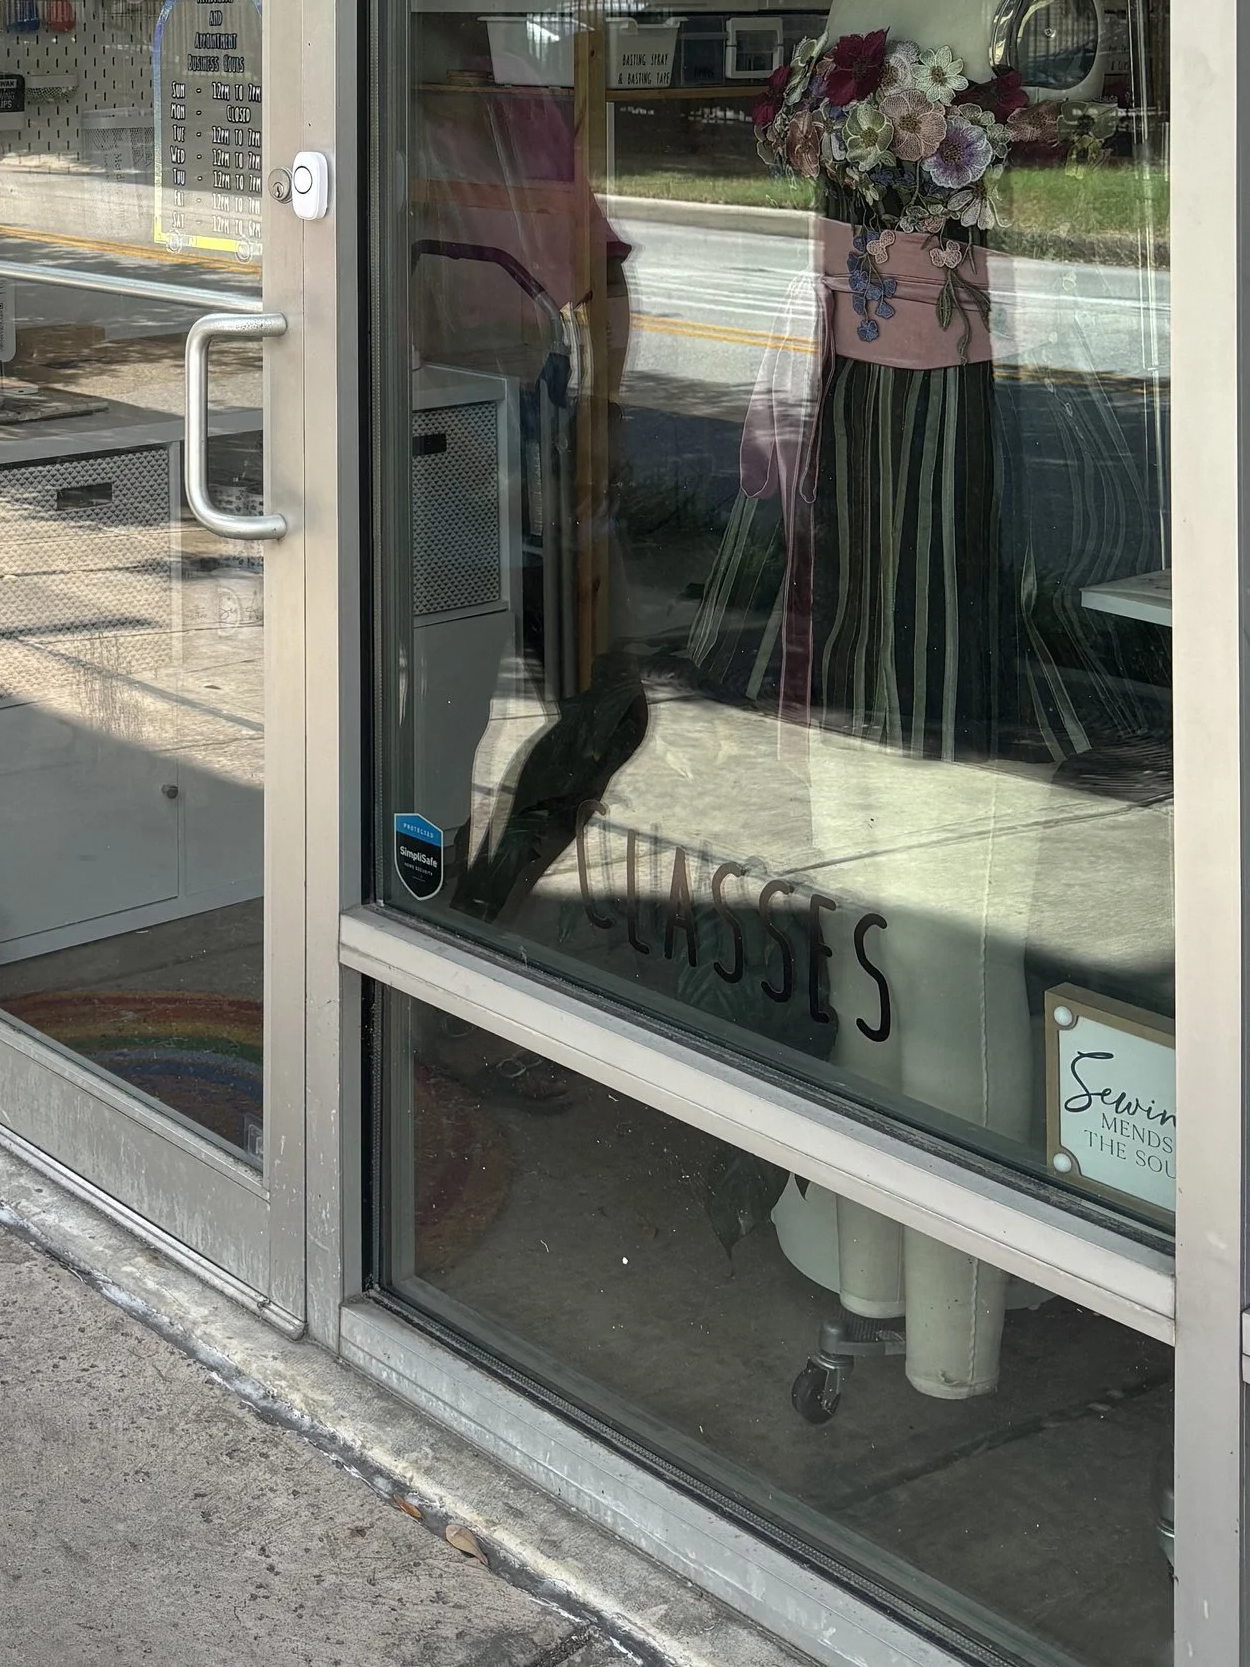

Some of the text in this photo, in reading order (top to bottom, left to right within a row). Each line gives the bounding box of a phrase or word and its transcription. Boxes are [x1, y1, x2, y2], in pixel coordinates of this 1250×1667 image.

[209, 10, 223, 27] AND
[194, 32, 238, 50] APPOINTMENT
[187, 54, 219, 72] BUSINESS
[622, 53, 669, 67] BASTING SPRAY
[627, 72, 652, 85] BASTING
[656, 71, 671, 85] TAPE
[172, 80, 186, 99] SUN
[170, 102, 186, 120] MON
[226, 104, 252, 124] CLOSED
[173, 124, 186, 143] TUE
[170, 145, 186, 164] WED
[174, 189, 185, 207] FRI
[172, 210, 185, 229] SAT
[403, 822, 435, 839] PROTECTED
[399, 845, 438, 869] SimpliSafe
[575, 799, 892, 1043] CLASSES
[1101, 1112, 1174, 1154] MENDS
[1084, 1130, 1127, 1161] THE
